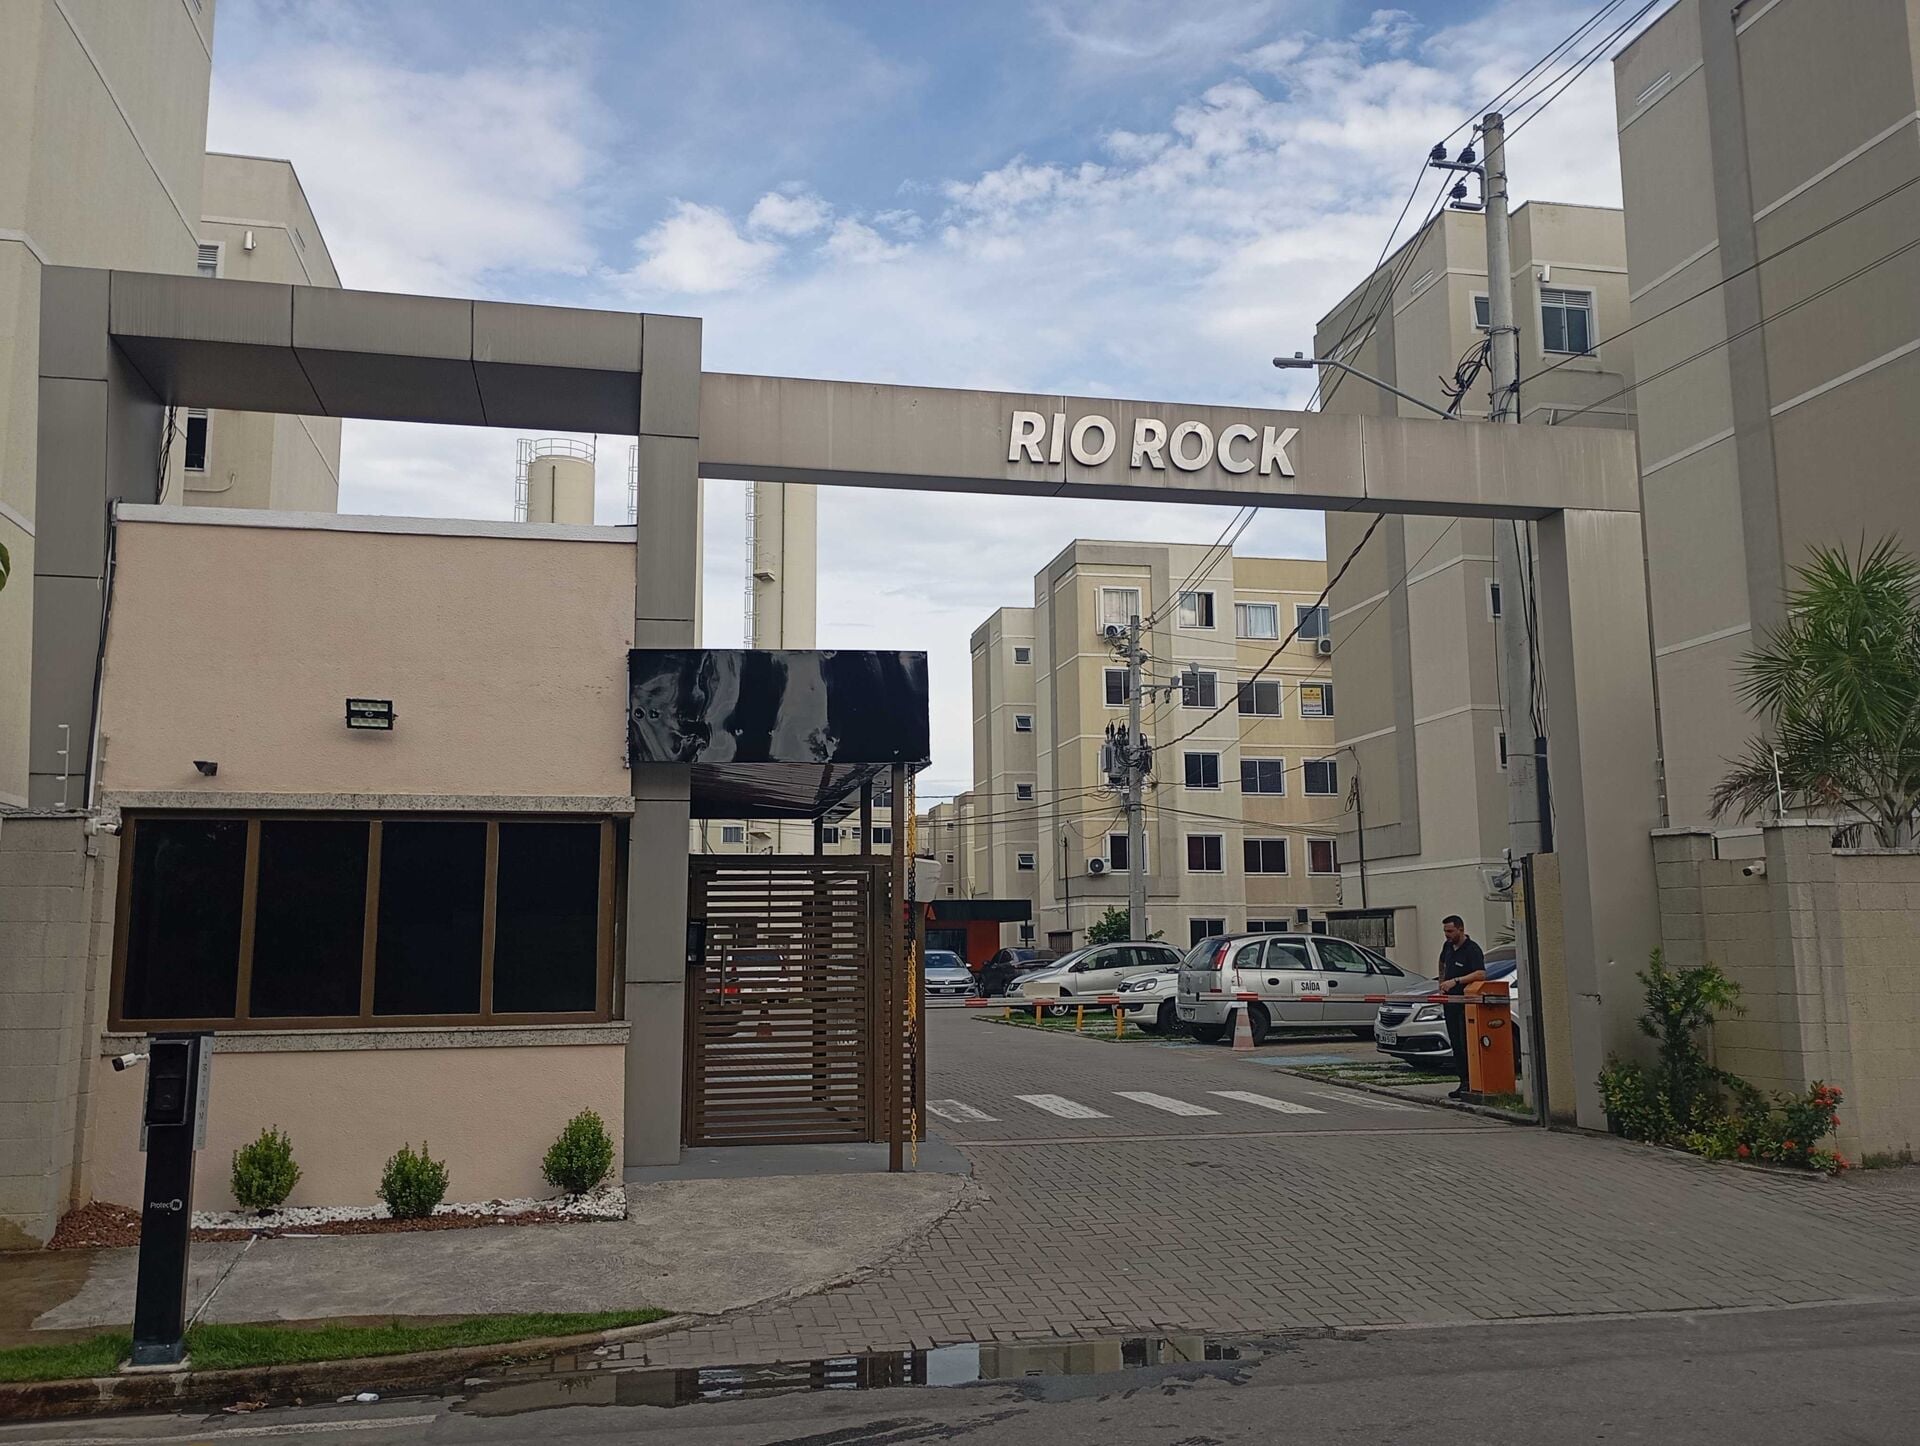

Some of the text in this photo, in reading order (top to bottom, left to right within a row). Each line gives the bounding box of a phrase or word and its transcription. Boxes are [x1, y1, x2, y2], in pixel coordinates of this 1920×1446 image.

[1008, 410, 1300, 478] RIO ROCK
[1300, 980, 1321, 992] SAÍDA
